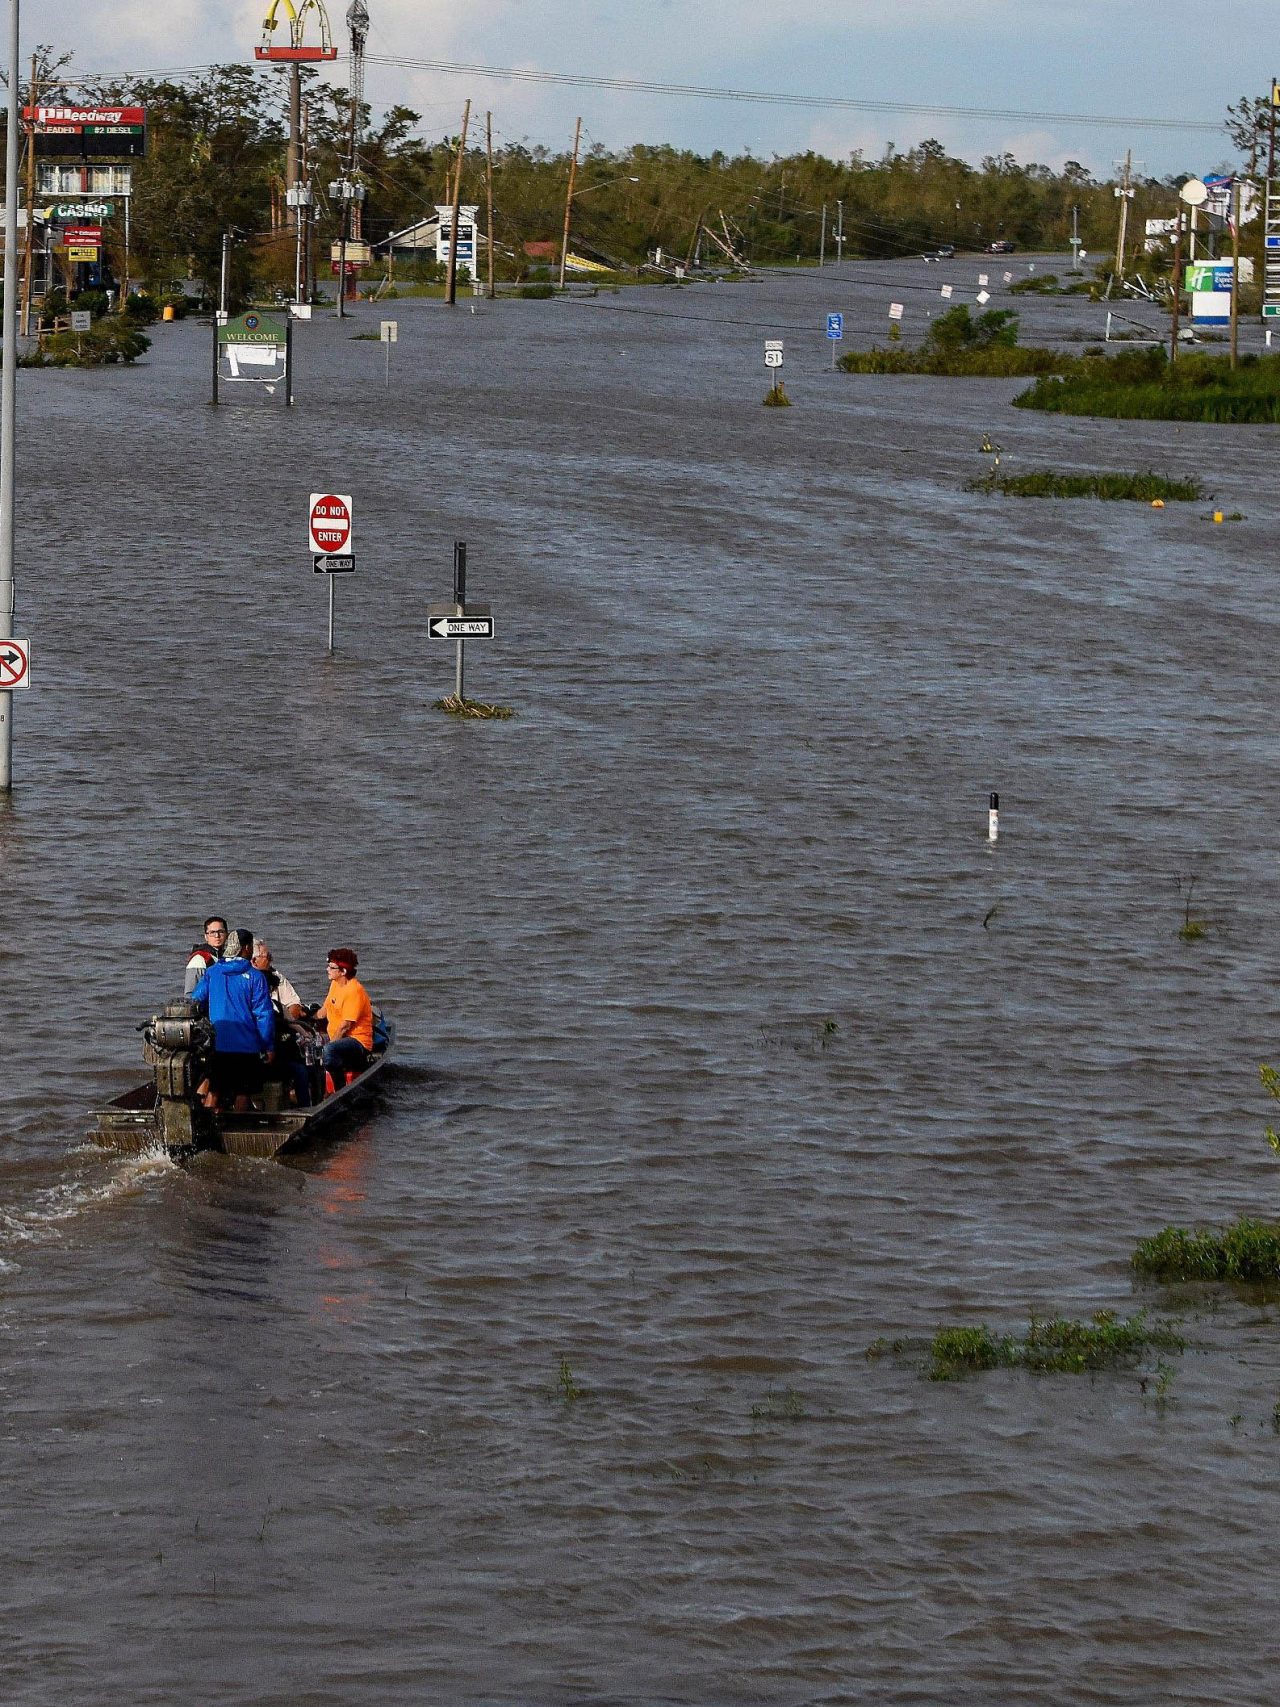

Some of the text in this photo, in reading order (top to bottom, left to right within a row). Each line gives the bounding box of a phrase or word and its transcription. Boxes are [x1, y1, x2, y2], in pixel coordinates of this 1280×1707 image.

[57, 205, 108, 217] CASINO
[768, 354, 778, 363] 51
[315, 506, 345, 516] DO NOT
[318, 531, 342, 542] ENTER
[326, 560, 352, 568] ONE WAY
[448, 623, 487, 632] ONE WAY
